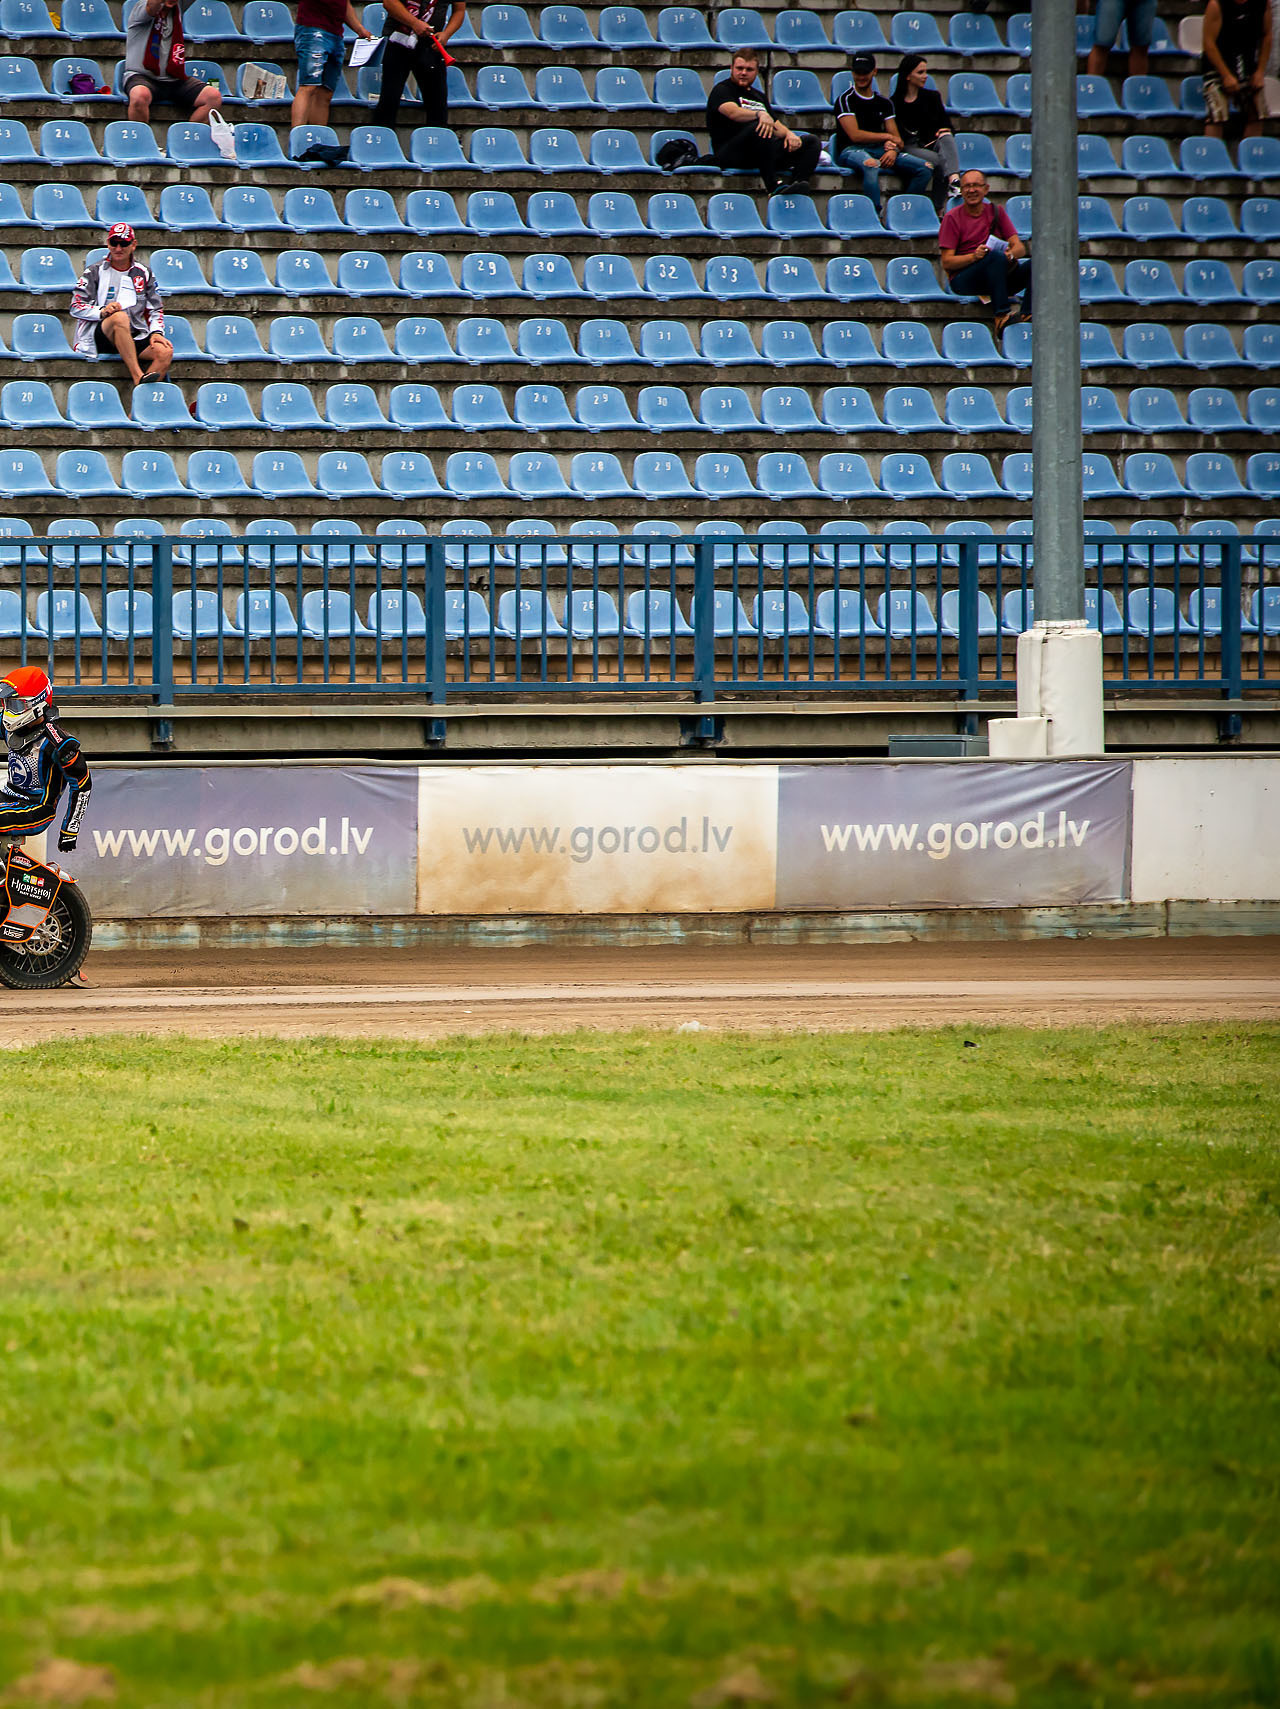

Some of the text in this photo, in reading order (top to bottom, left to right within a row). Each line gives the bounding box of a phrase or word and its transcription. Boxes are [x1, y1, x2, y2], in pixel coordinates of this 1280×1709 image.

[39, 255, 54, 267] 22
[166, 255, 183, 270] 24
[232, 256, 249, 270] 25
[295, 257, 311, 270] 26
[354, 258, 369, 270] 27
[416, 258, 434, 273] 28
[537, 261, 555, 273] 30
[477, 259, 497, 276] 29
[598, 261, 613, 275] 31
[659, 263, 679, 279] 32
[783, 263, 798, 276] 34
[844, 264, 861, 277] 35
[901, 264, 919, 275] 36
[1140, 265, 1159, 280] 40
[721, 265, 738, 283] 33
[21, 391, 34, 403] 20
[89, 391, 104, 402] 21
[152, 391, 165, 402] 22
[215, 393, 228, 404] 23
[343, 391, 358, 403] 25
[408, 392, 421, 403] 26
[471, 393, 484, 404] 27
[593, 393, 609, 405] 29
[779, 396, 792, 406] 32
[841, 397, 857, 407] 33
[962, 395, 975, 406] 35
[720, 399, 732, 409] 31
[12, 461, 24, 472] 19
[76, 462, 89, 474] 20
[142, 460, 157, 472] 21
[207, 462, 221, 474] 22
[400, 460, 415, 472] 25
[527, 460, 542, 472] 27
[590, 460, 604, 472] 28
[654, 461, 672, 472] 29
[714, 463, 730, 474] 30
[778, 462, 792, 474] 31
[839, 462, 853, 473] 32
[898, 463, 915, 475] 33
[1083, 464, 1095, 476] 36
[92, 817, 374, 866] www.gorod.lv
[462, 816, 734, 864] www.gorod.lv
[820, 811, 1091, 860] www.gorod.lv
